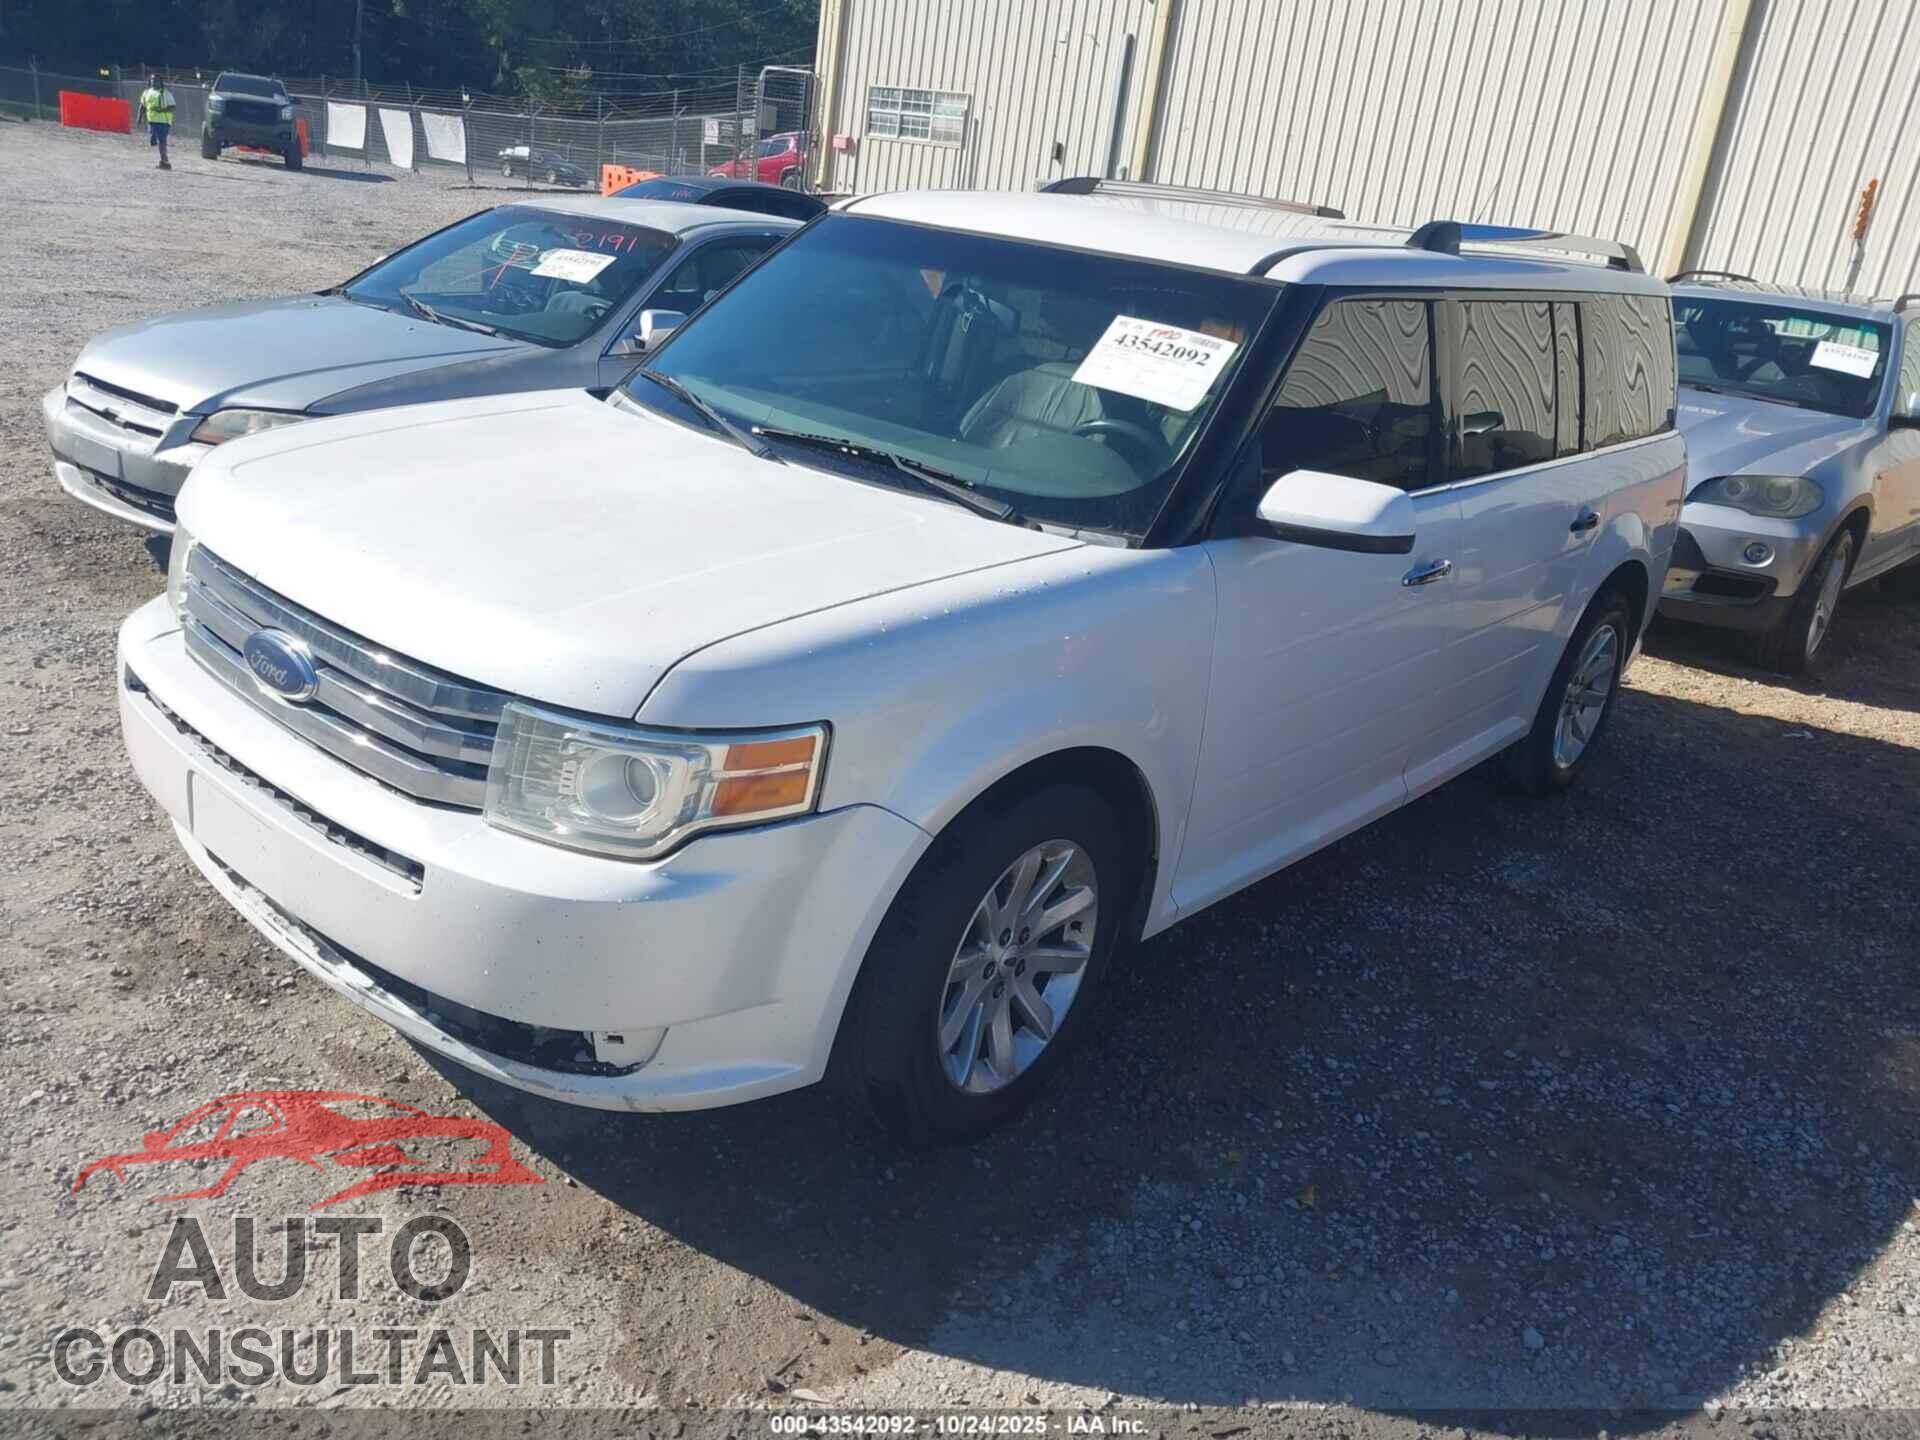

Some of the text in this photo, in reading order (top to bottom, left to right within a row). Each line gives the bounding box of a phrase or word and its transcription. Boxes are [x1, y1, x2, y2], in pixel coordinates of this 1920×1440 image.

[576, 233, 637, 253] 2191
[1114, 333, 1211, 367] 43542092
[250, 650, 288, 686] Ford
